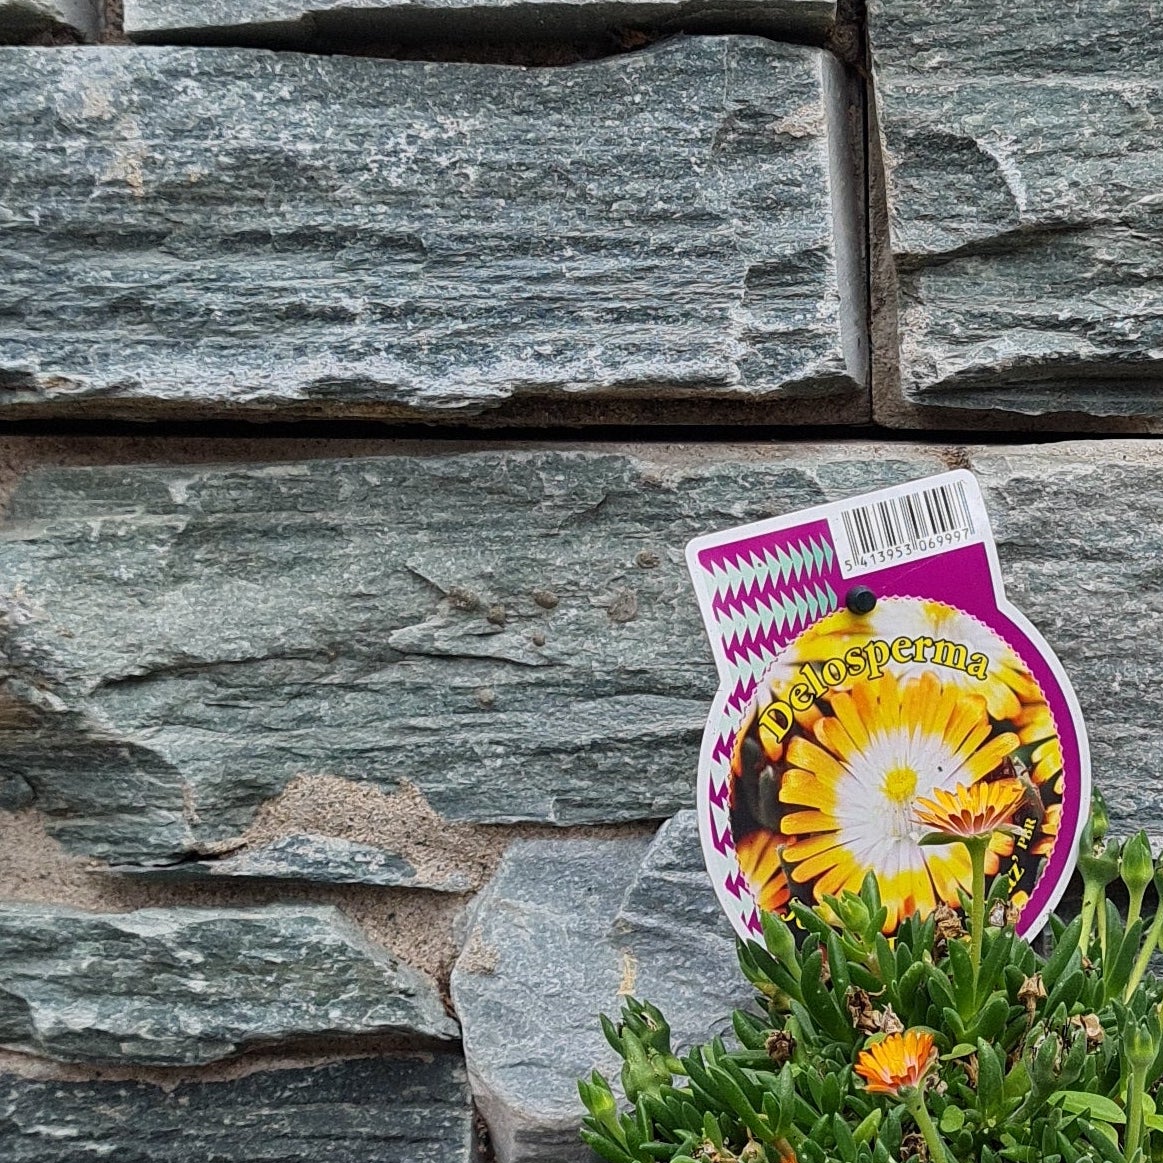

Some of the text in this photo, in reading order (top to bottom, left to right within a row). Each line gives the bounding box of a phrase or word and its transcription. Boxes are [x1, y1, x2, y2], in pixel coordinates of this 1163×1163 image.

[844, 528, 969, 571] 5 413953 069997
[758, 635, 989, 744] Delosperma
